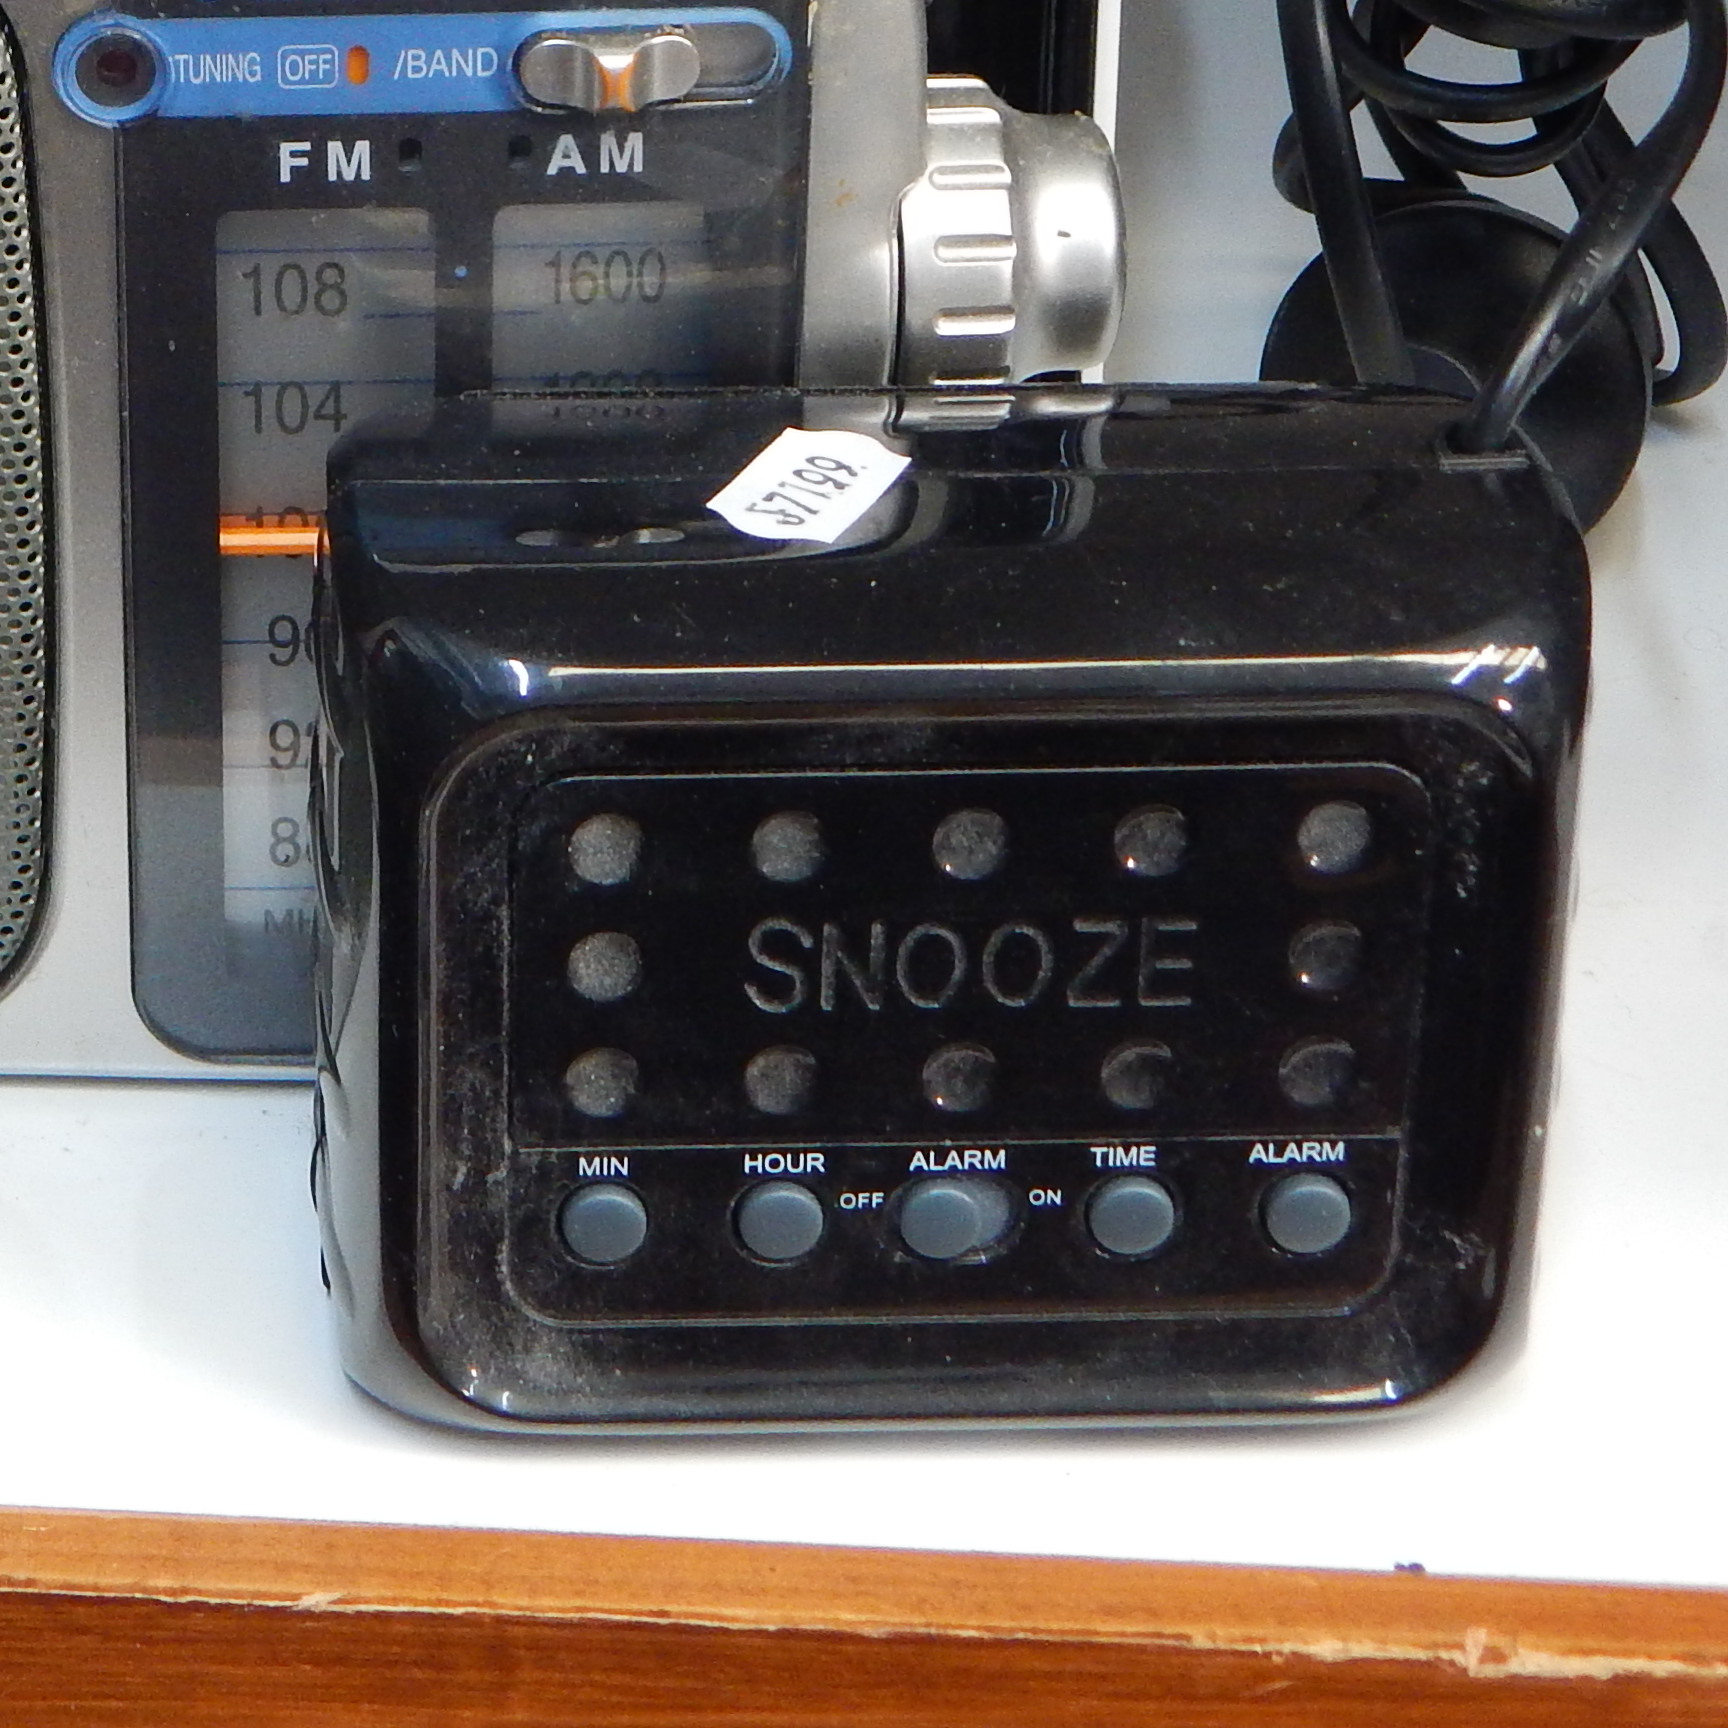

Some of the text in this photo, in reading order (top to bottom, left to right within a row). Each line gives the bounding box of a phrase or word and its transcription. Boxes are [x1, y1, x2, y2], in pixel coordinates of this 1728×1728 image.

[174, 46, 500, 84] TUNING OFF /BAND
[544, 247, 667, 306] 1600
[241, 261, 348, 318] 108
[242, 380, 348, 436] 104
[743, 916, 1198, 1014] SNOOZE
[743, 1153, 826, 1174] HOUR
[908, 1148, 1007, 1172] ALARM
[1090, 1145, 1157, 1167] TIME
[1248, 1141, 1346, 1164] ALARM
[578, 1156, 630, 1176] MIN
[838, 1191, 885, 1210] OFF
[1028, 1188, 1062, 1207] ON
